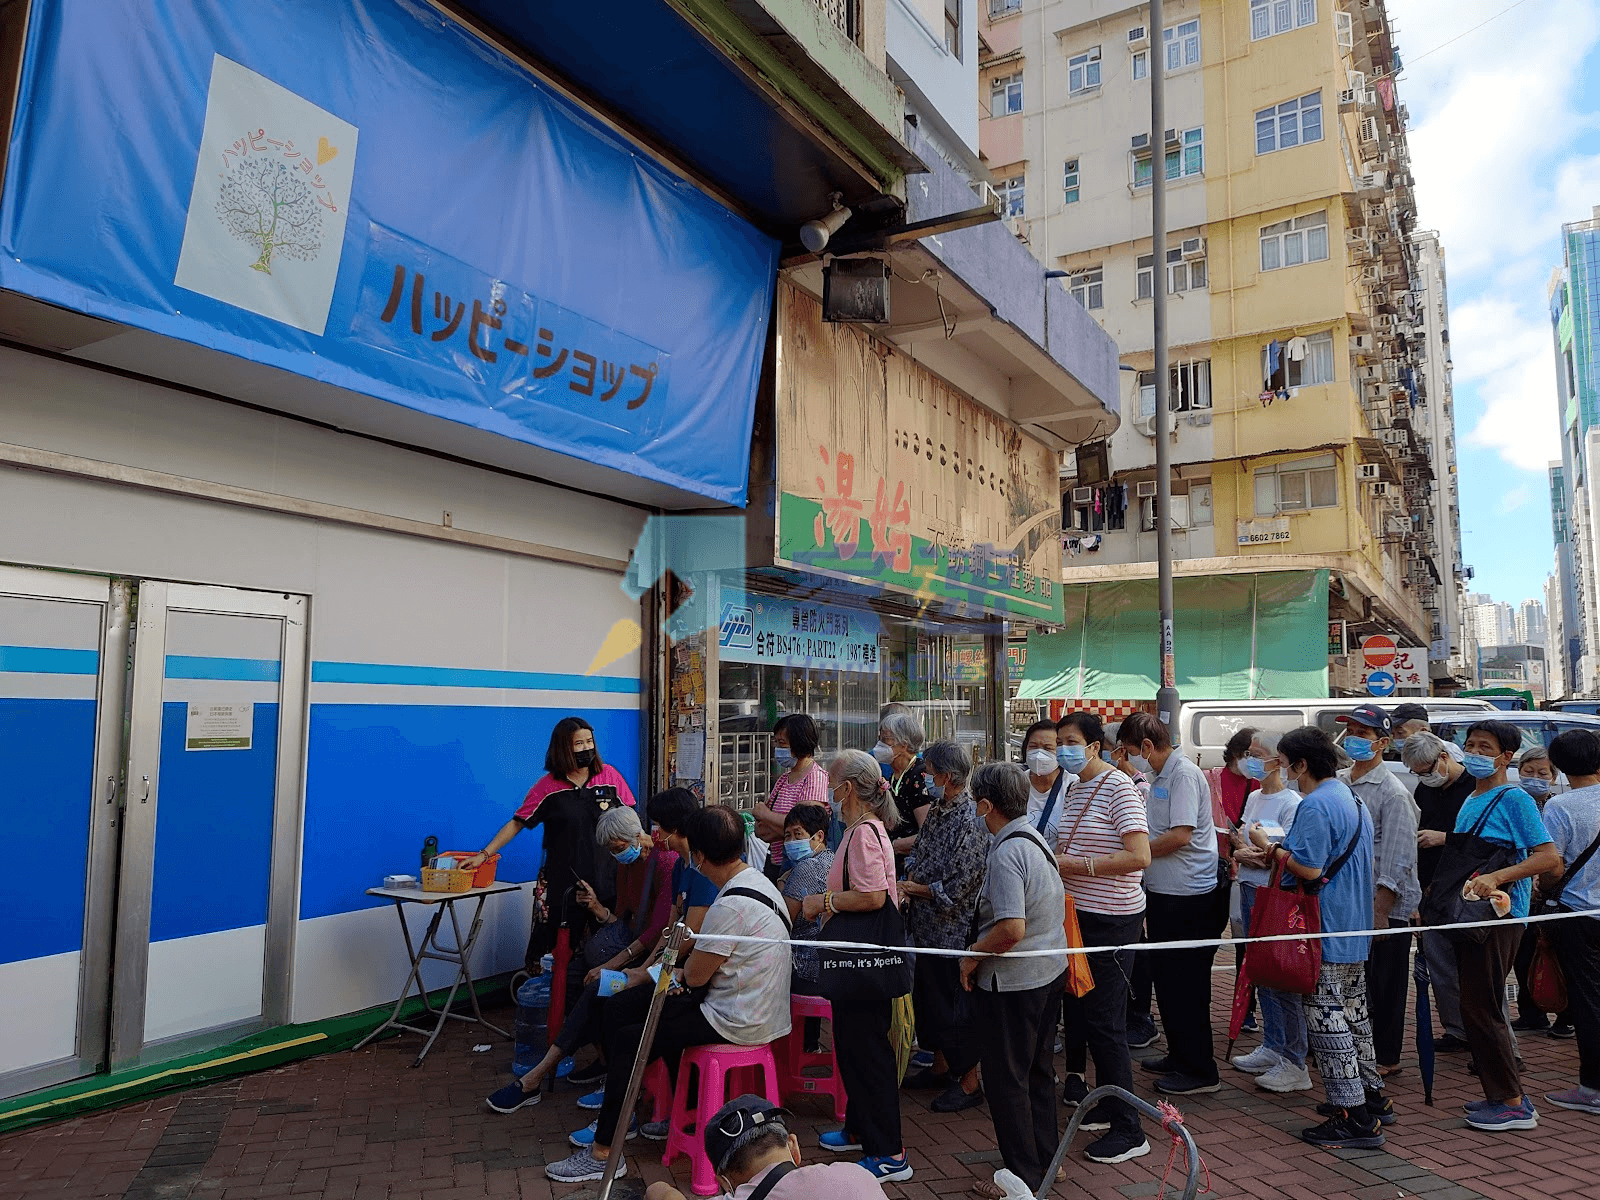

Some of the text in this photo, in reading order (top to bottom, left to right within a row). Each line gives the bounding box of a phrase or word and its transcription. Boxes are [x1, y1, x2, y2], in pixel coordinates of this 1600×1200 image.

[222, 128, 337, 212] ハッピーショップ
[380, 264, 659, 410] ハッピーショップ
[1250, 531, 1290, 542] 6602 7862
[823, 960, 837, 970] It's
[857, 958, 872, 968] it's
